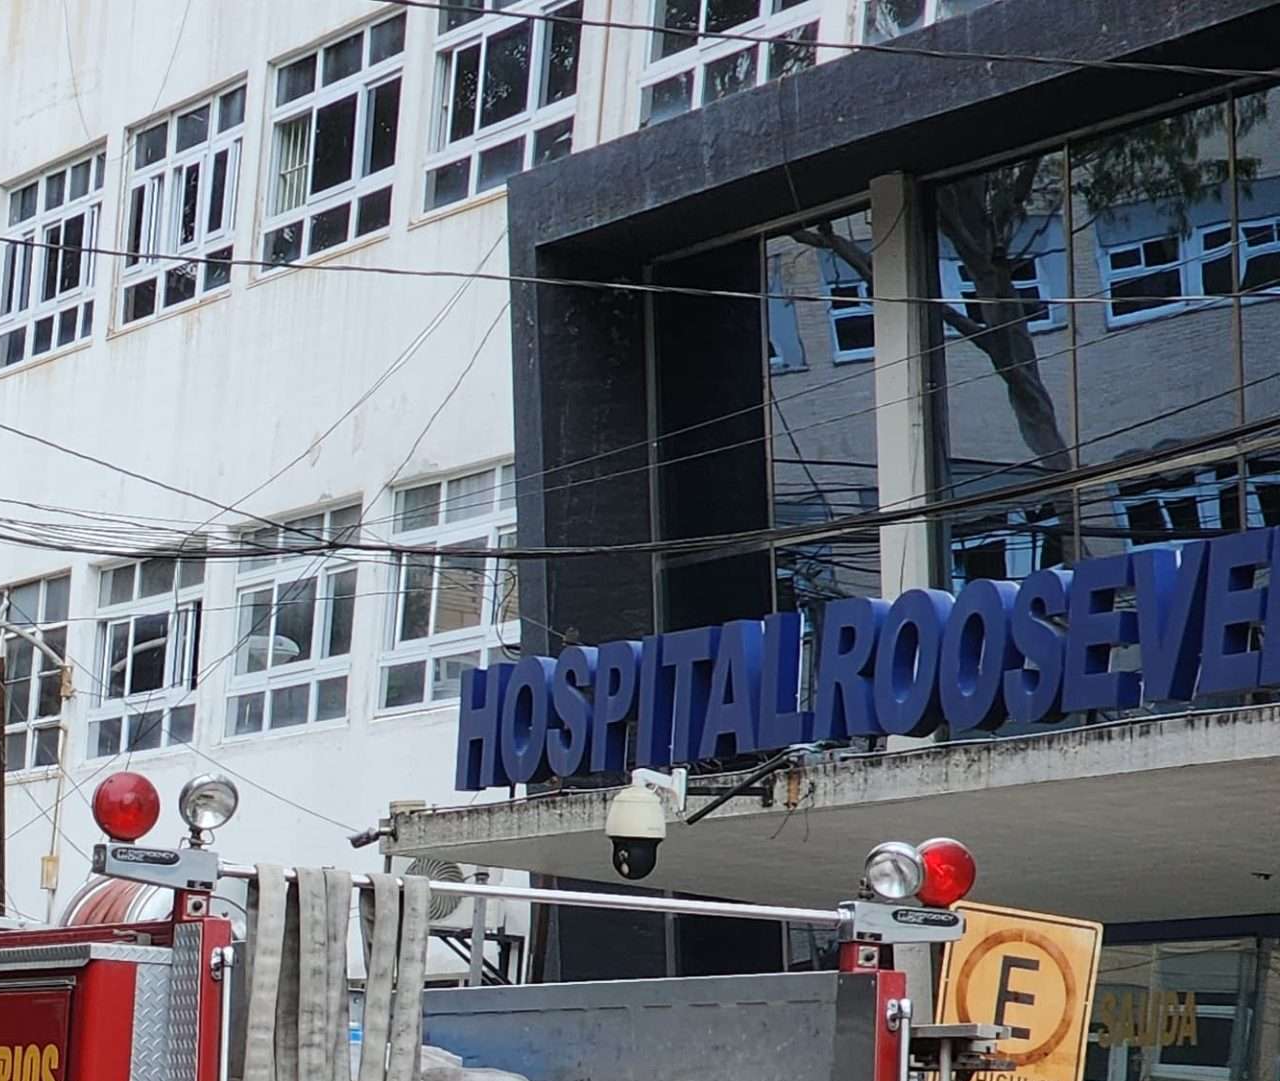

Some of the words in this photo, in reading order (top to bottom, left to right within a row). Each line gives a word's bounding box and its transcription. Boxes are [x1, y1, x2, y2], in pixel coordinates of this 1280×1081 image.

[456, 612, 814, 791] HOSPITAL
[994, 955, 1040, 1039] E
[1098, 991, 1197, 1048] SALIDA
